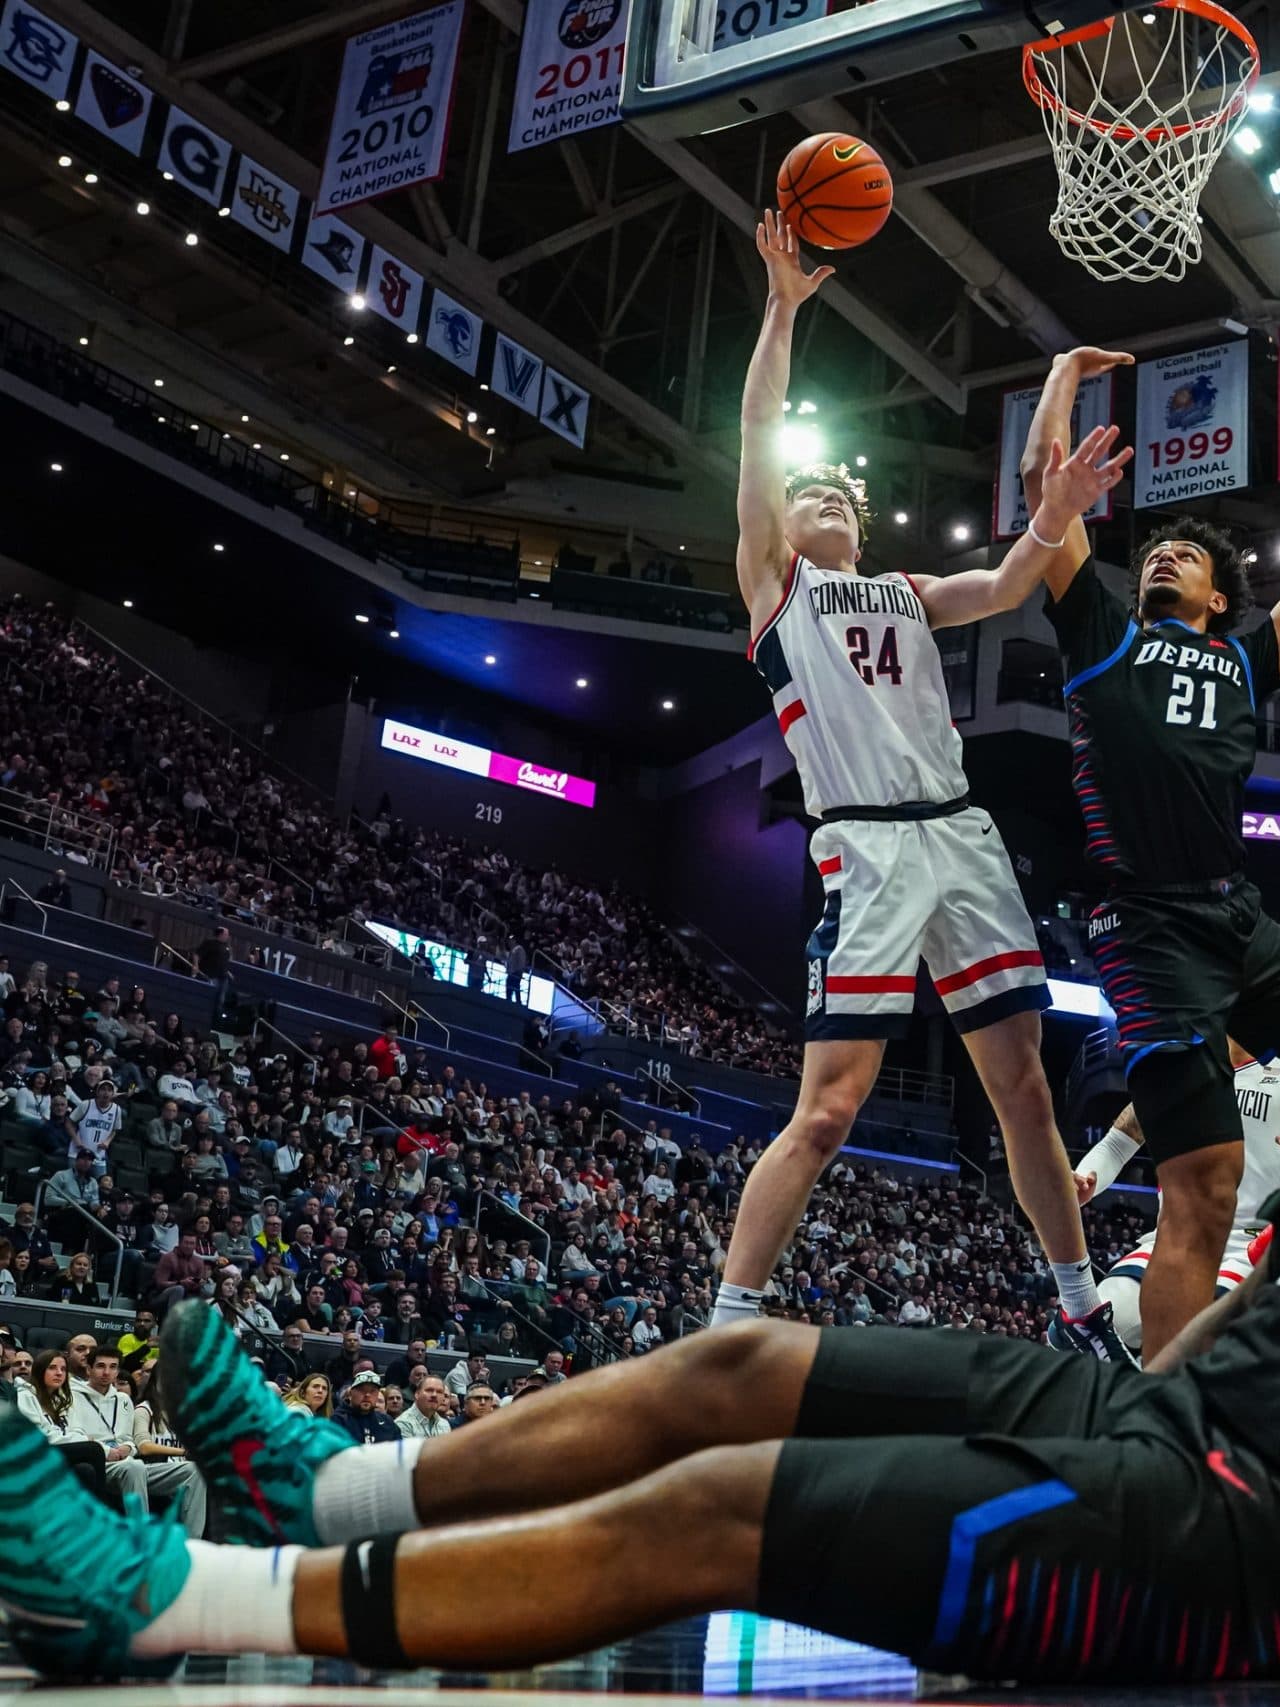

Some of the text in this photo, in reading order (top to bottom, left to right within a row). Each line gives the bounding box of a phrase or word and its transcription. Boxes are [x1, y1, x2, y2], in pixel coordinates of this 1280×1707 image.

[356, 27, 395, 46] UConn
[371, 25, 433, 56] Basketball
[534, 42, 625, 99] 2011
[532, 83, 621, 121] NATIONAL
[337, 105, 433, 164] 2010
[521, 104, 622, 144] CHAMPION
[339, 146, 422, 183] NATIONAL
[329, 163, 425, 204] CHAMPIONS
[1156, 345, 1230, 371] UConn Men's
[1162, 359, 1222, 382] Basketball
[1149, 426, 1234, 468] 1999
[1145, 475, 1236, 504] CHAMPIONS
[1151, 460, 1230, 485] NATIONAL
[809, 581, 923, 624] CONNECTICUT
[845, 625, 903, 687] 24
[1166, 673, 1218, 730] 21
[475, 803, 502, 824] 219
[94, 1319, 123, 1330] Bunker
